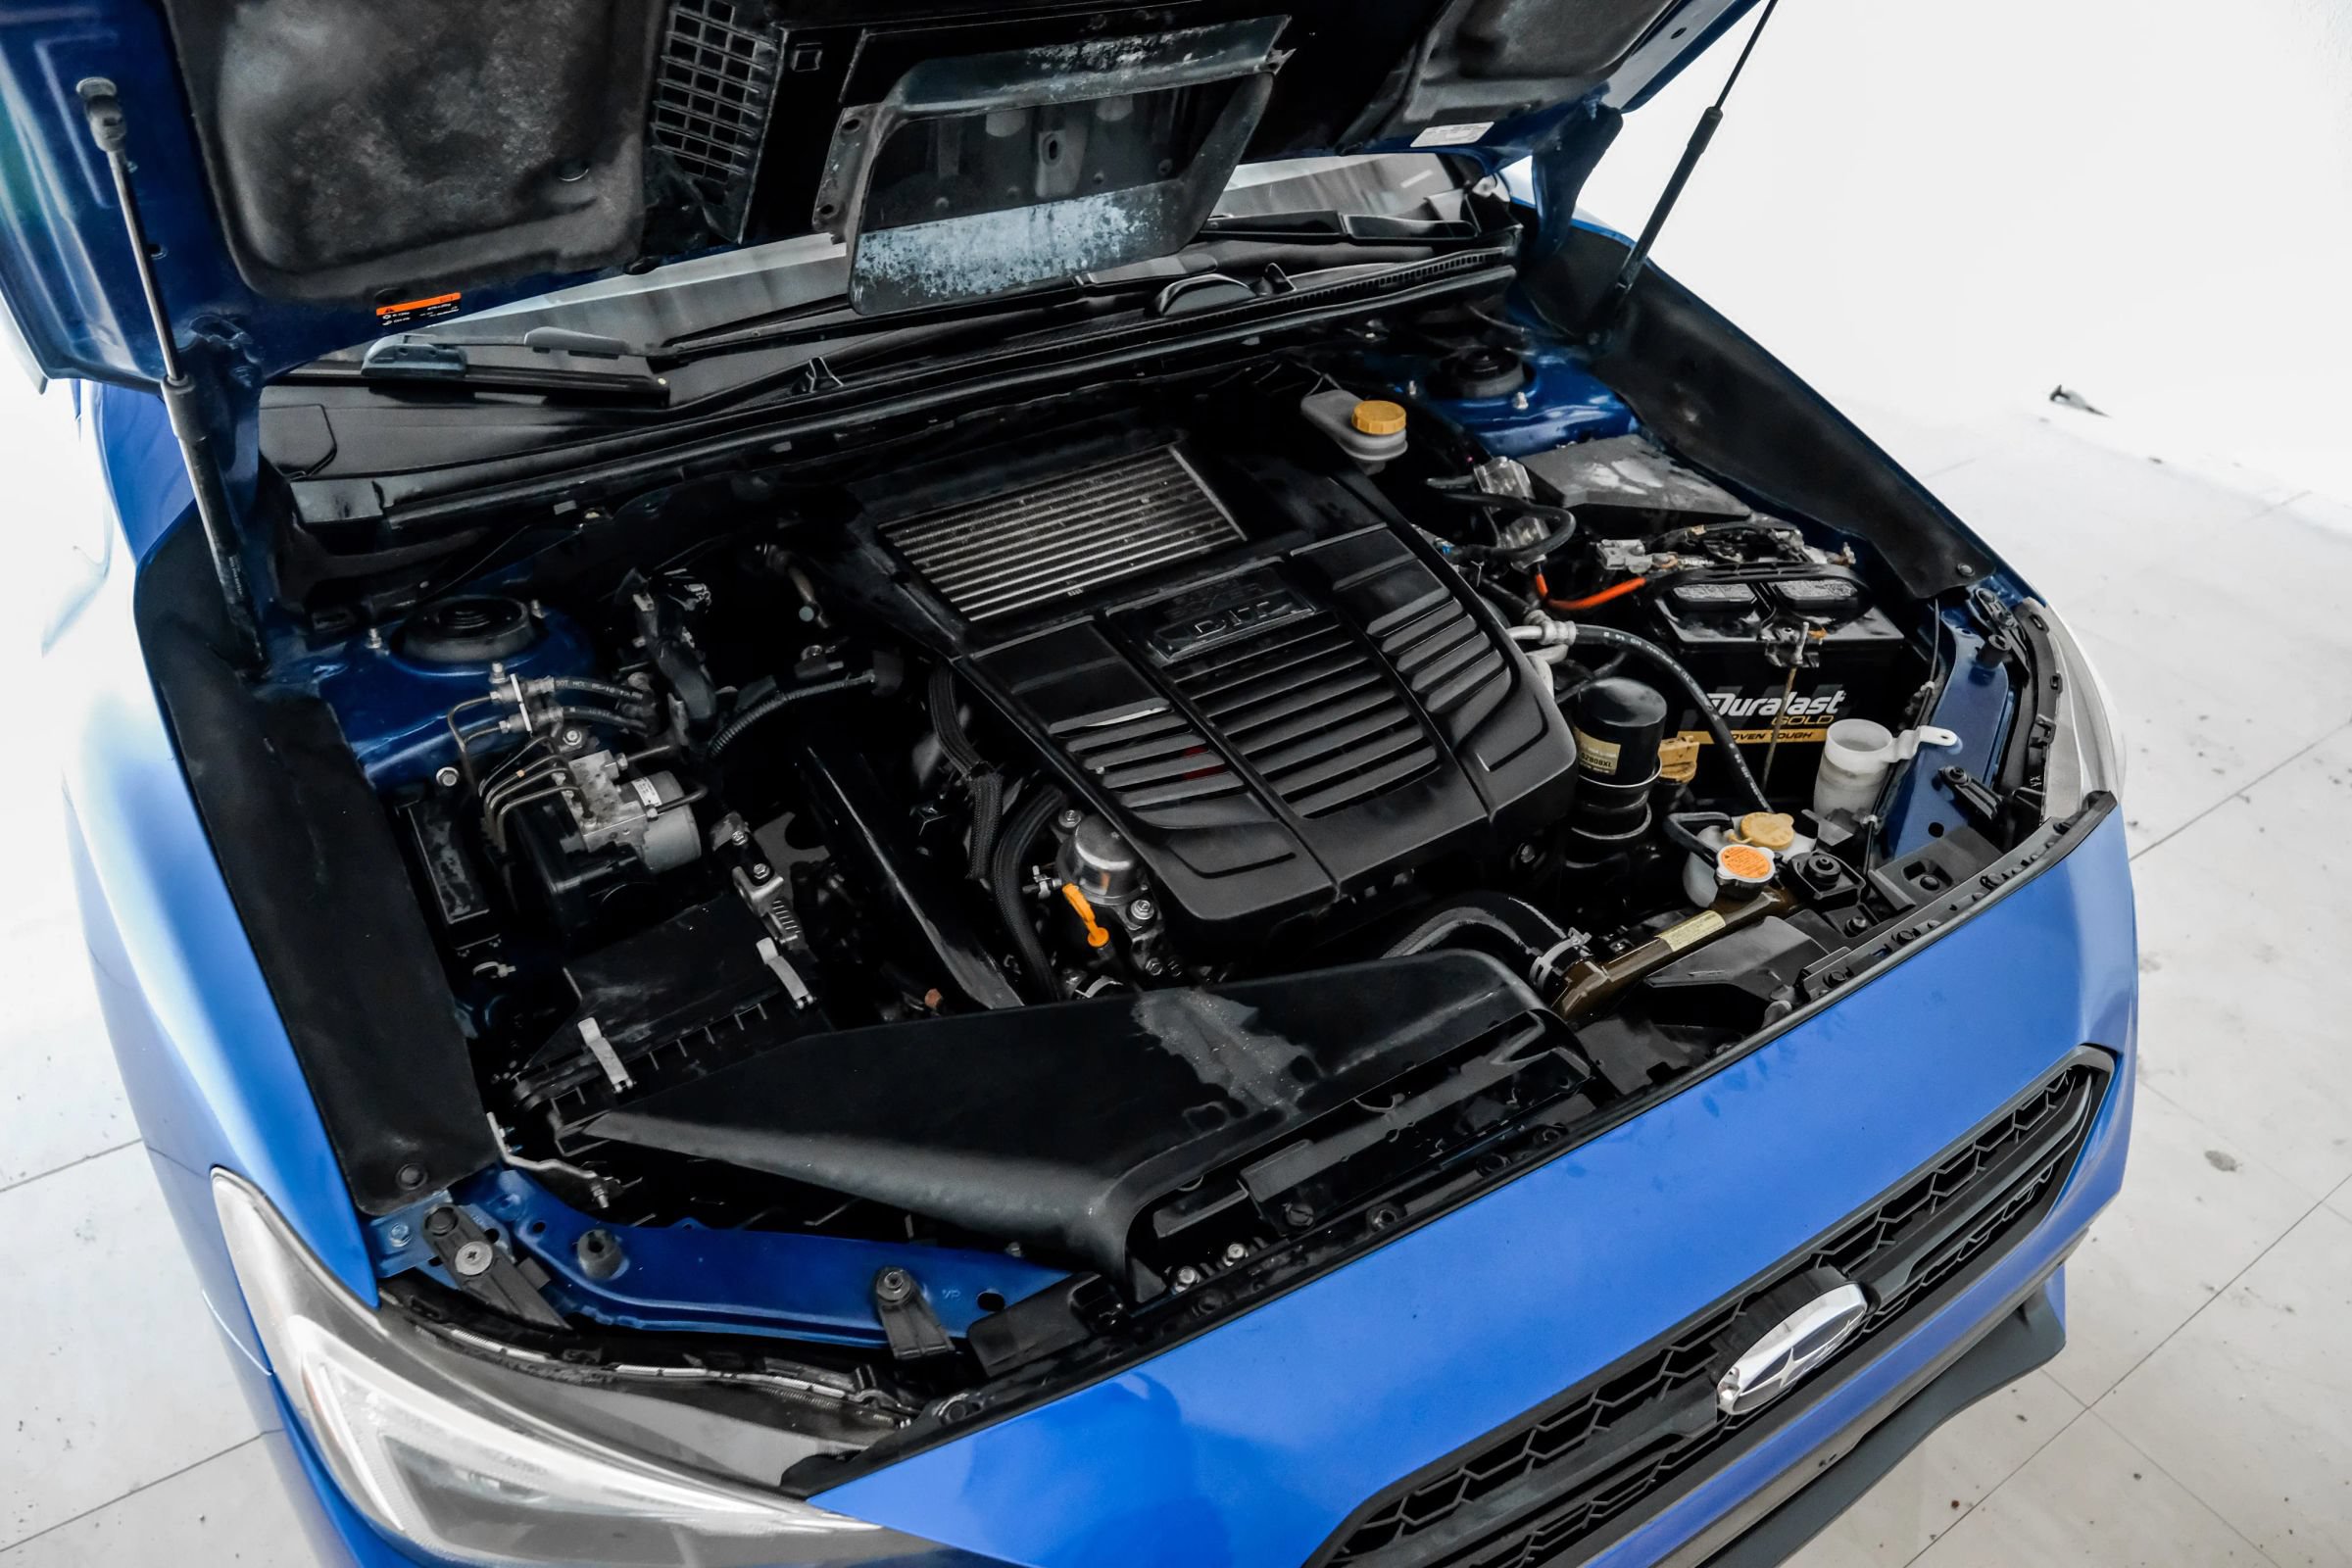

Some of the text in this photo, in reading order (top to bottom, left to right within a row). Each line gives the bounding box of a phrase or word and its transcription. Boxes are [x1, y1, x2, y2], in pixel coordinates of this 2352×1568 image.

[1706, 690, 1845, 717] Duralast
[1771, 715, 1835, 726] GOLD
[1771, 731, 1814, 740] OUGH
